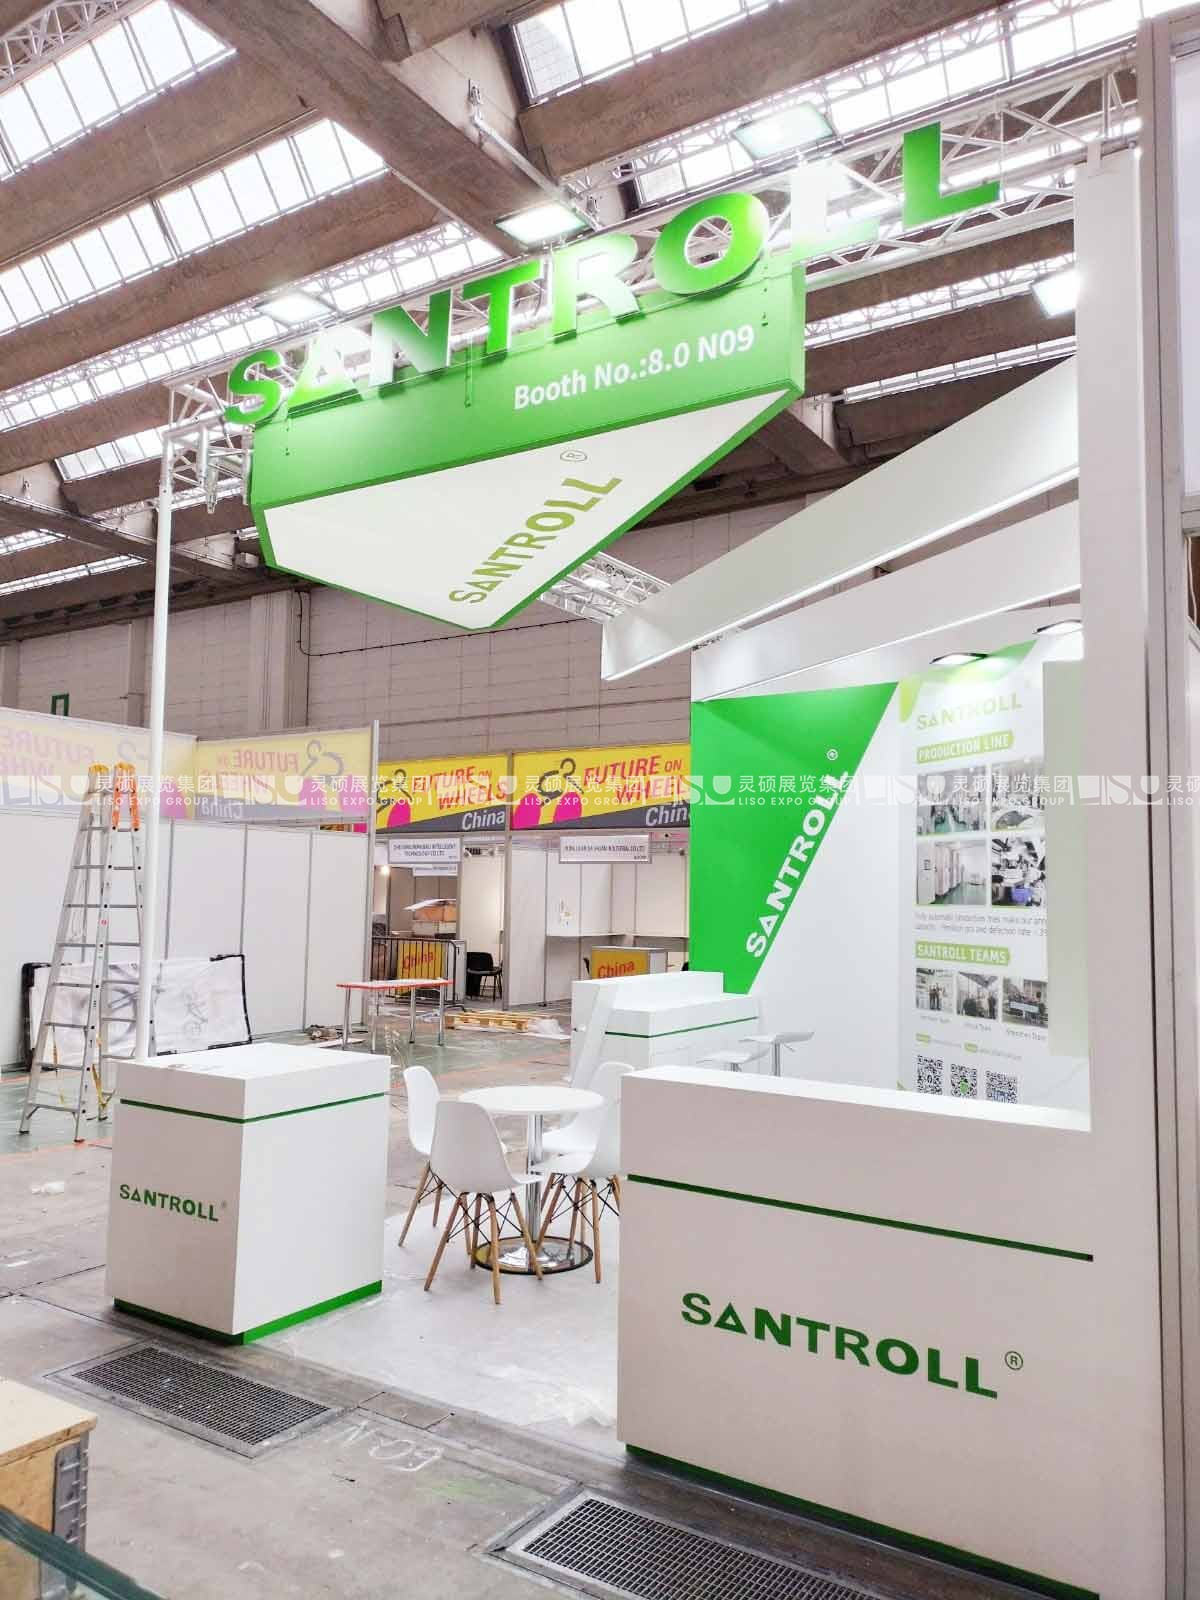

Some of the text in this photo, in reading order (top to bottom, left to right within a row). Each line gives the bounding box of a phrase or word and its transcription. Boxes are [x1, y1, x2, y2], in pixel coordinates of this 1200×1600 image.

[224, 121, 1000, 426] SANTROLL
[513, 324, 755, 410] Booth No.:8.0 N09
[449, 477, 623, 604] SANTROLL
[582, 755, 682, 787] FUTURE ON
[615, 775, 690, 804] WHEEL
[461, 809, 506, 831] China
[645, 803, 690, 827] Chin
[745, 771, 849, 958] SANTROLL
[970, 947, 1007, 965] TEAMS
[119, 1183, 219, 1223] SANTROLL
[681, 1291, 998, 1400] SANTROLL
